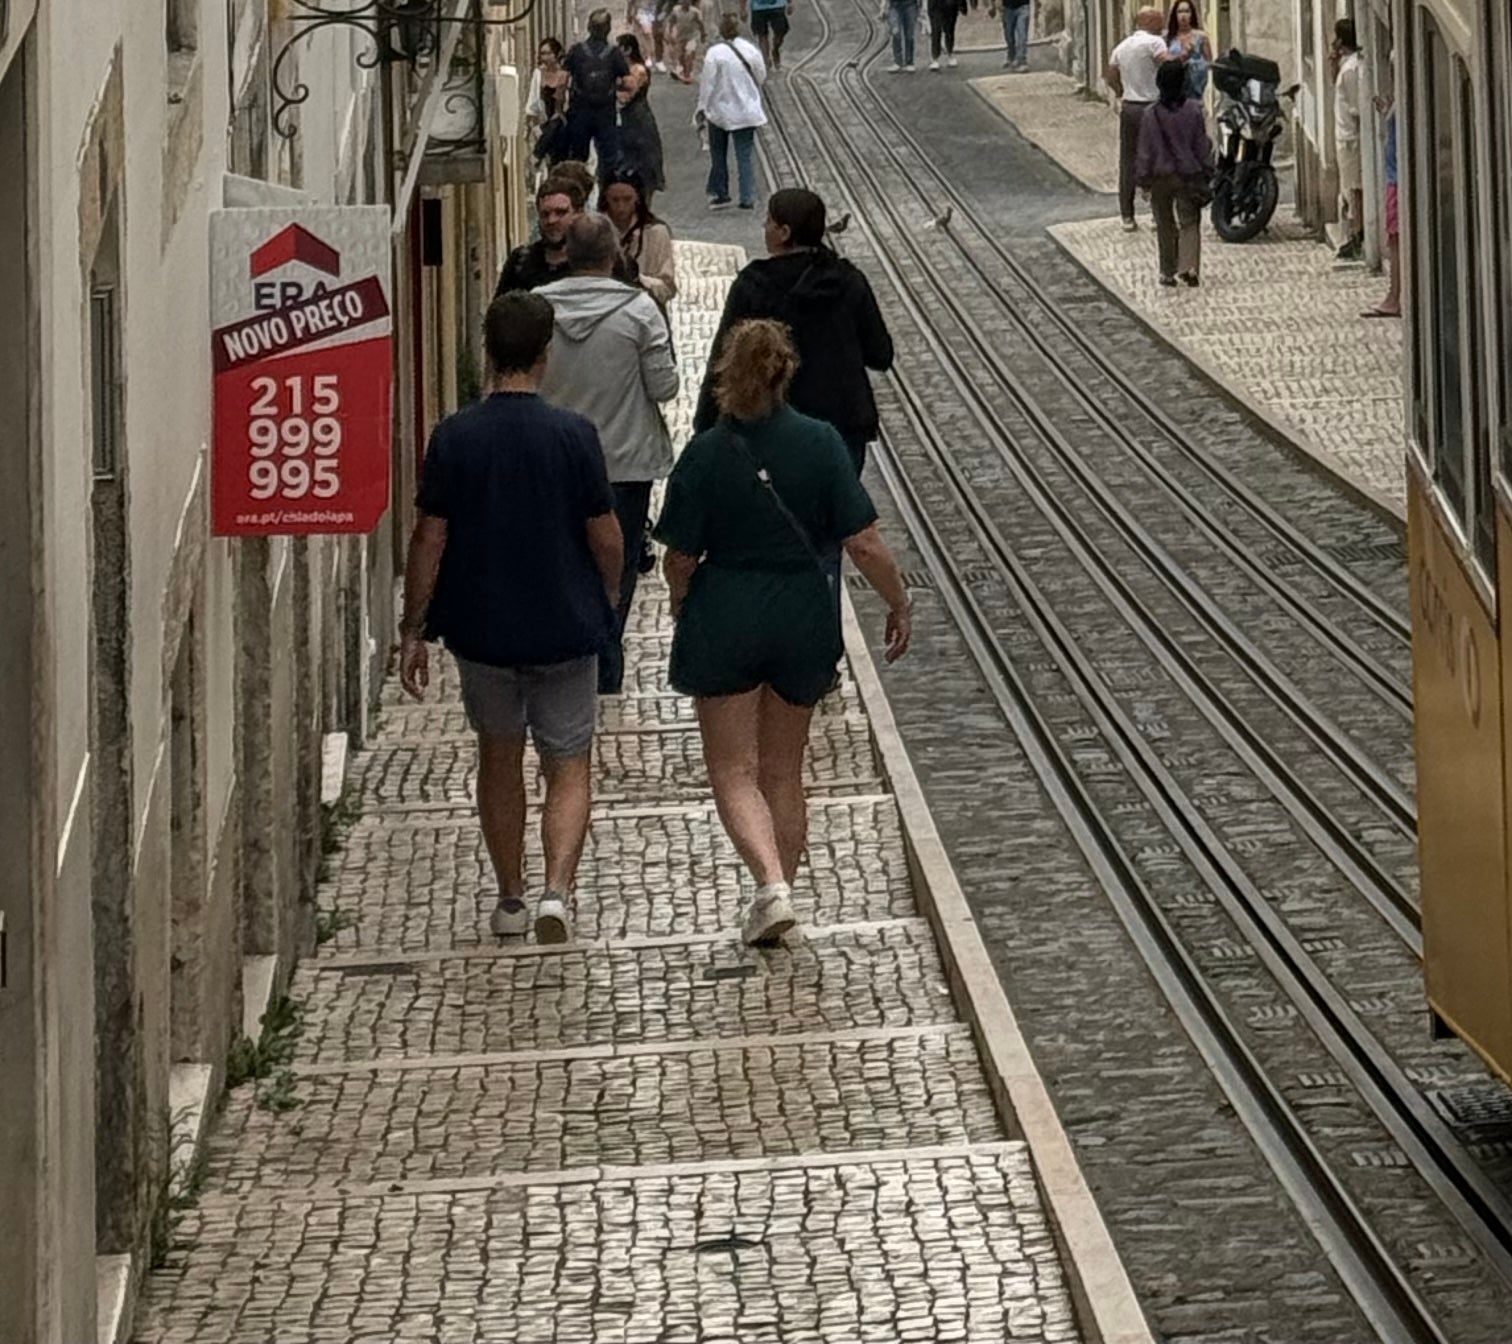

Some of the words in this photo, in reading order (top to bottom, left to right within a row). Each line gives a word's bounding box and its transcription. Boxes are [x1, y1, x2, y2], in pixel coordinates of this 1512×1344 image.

[254, 280, 328, 311] ERA
[222, 316, 289, 362] NOVO
[289, 290, 363, 339] PREÇO
[250, 374, 340, 416] 215
[248, 417, 342, 457] 999
[248, 459, 341, 499] 995
